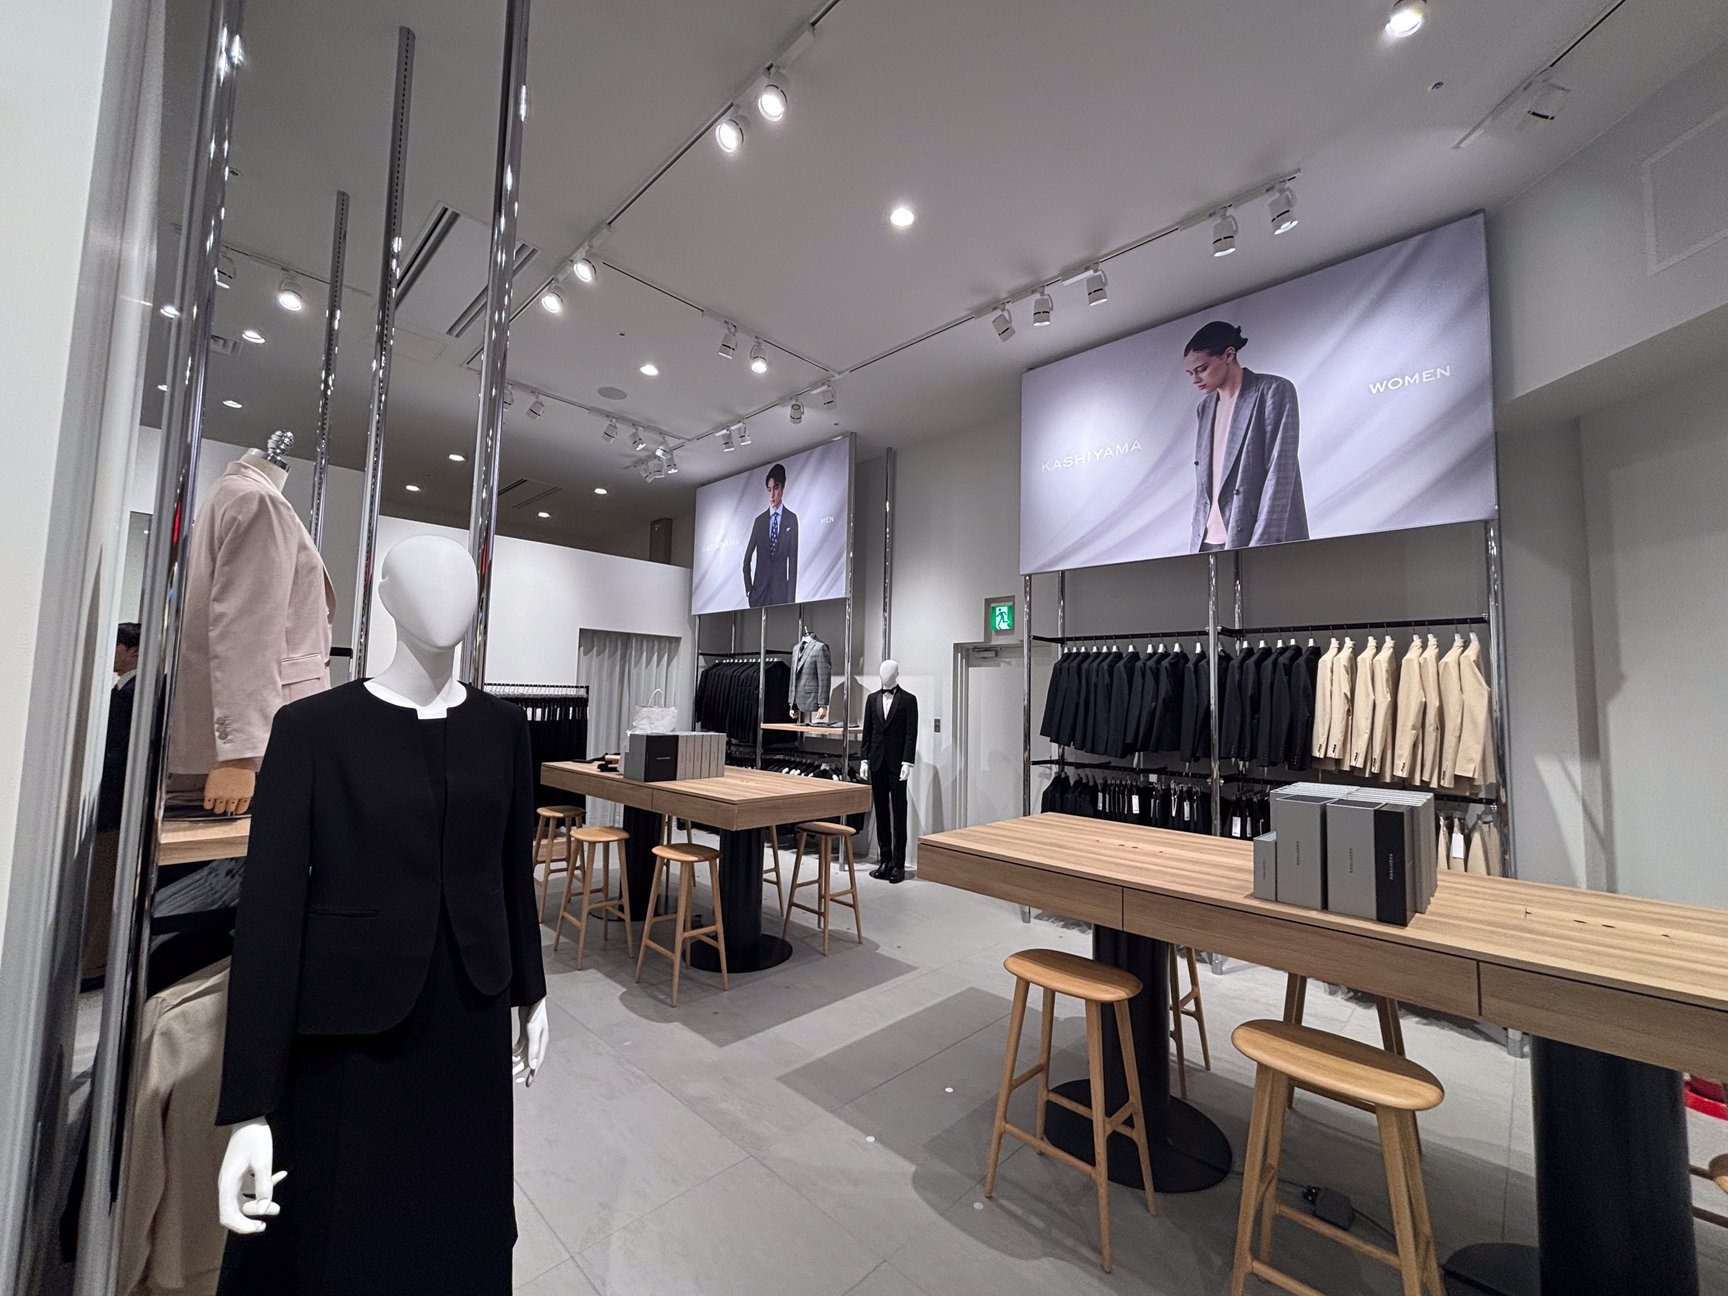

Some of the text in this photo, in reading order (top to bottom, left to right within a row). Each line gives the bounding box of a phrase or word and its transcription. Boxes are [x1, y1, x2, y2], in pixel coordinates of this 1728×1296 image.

[1368, 365, 1451, 395] WOMEN
[1040, 439, 1143, 473] KASHIYAMA
[820, 515, 835, 525] MEN
